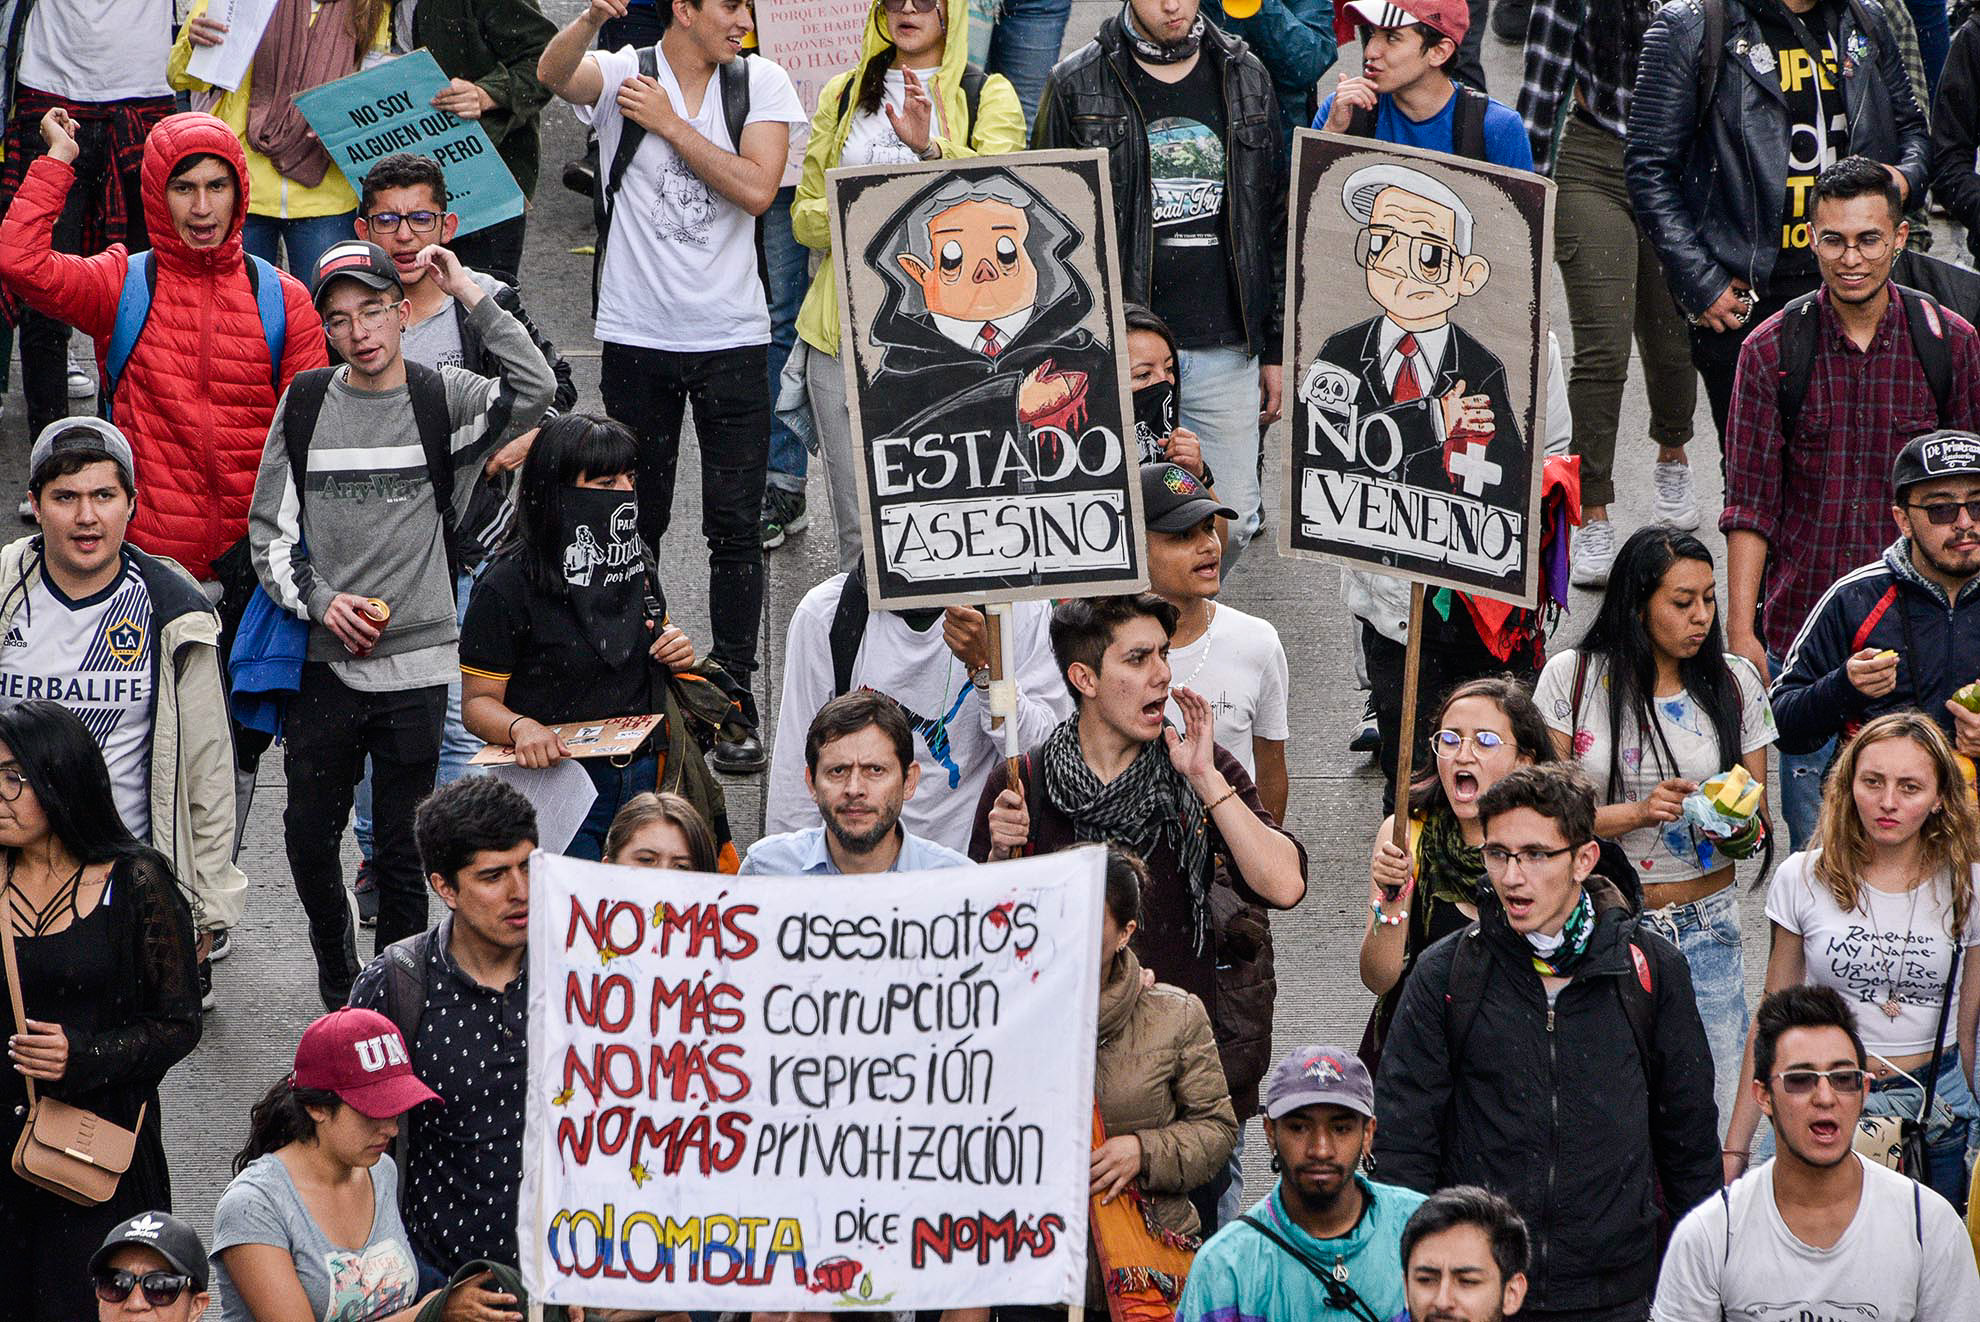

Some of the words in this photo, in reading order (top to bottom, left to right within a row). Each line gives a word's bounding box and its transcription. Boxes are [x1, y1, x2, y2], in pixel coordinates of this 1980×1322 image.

[771, 7, 827, 22] PORQUE
[832, 4, 850, 15] NO
[802, 23, 821, 34] DE
[774, 38, 834, 53] RAZONES
[349, 105, 387, 129] NO
[387, 91, 425, 119] SOY
[346, 124, 423, 164] ALGUIEN
[420, 110, 461, 137] QUE
[433, 134, 484, 168] PERO
[1304, 400, 1403, 474] NO
[871, 425, 1122, 496] ESTADO
[893, 499, 1121, 564] ASESINO
[1317, 473, 1514, 561] VENENO
[3, 640, 28, 648] adidas
[115, 635, 137, 648] LA
[565, 894, 645, 957] NO
[660, 889, 759, 961] MÁS
[777, 898, 1039, 962] asesinatos
[1846, 926, 1935, 944] Remember
[1826, 936, 1862, 959] My
[1905, 960, 1939, 980] Be
[565, 970, 634, 1034] NO
[649, 969, 746, 1038] MÁS
[1859, 988, 1878, 1004] It
[355, 1033, 409, 1072] UN
[563, 1043, 642, 1107] NO
[648, 1039, 752, 1103] MÁS
[769, 1033, 994, 1109] represión
[752, 1106, 1044, 1187] privatización
[124, 1230, 159, 1239] adidas
[547, 1203, 809, 1286] COLOMBIA
